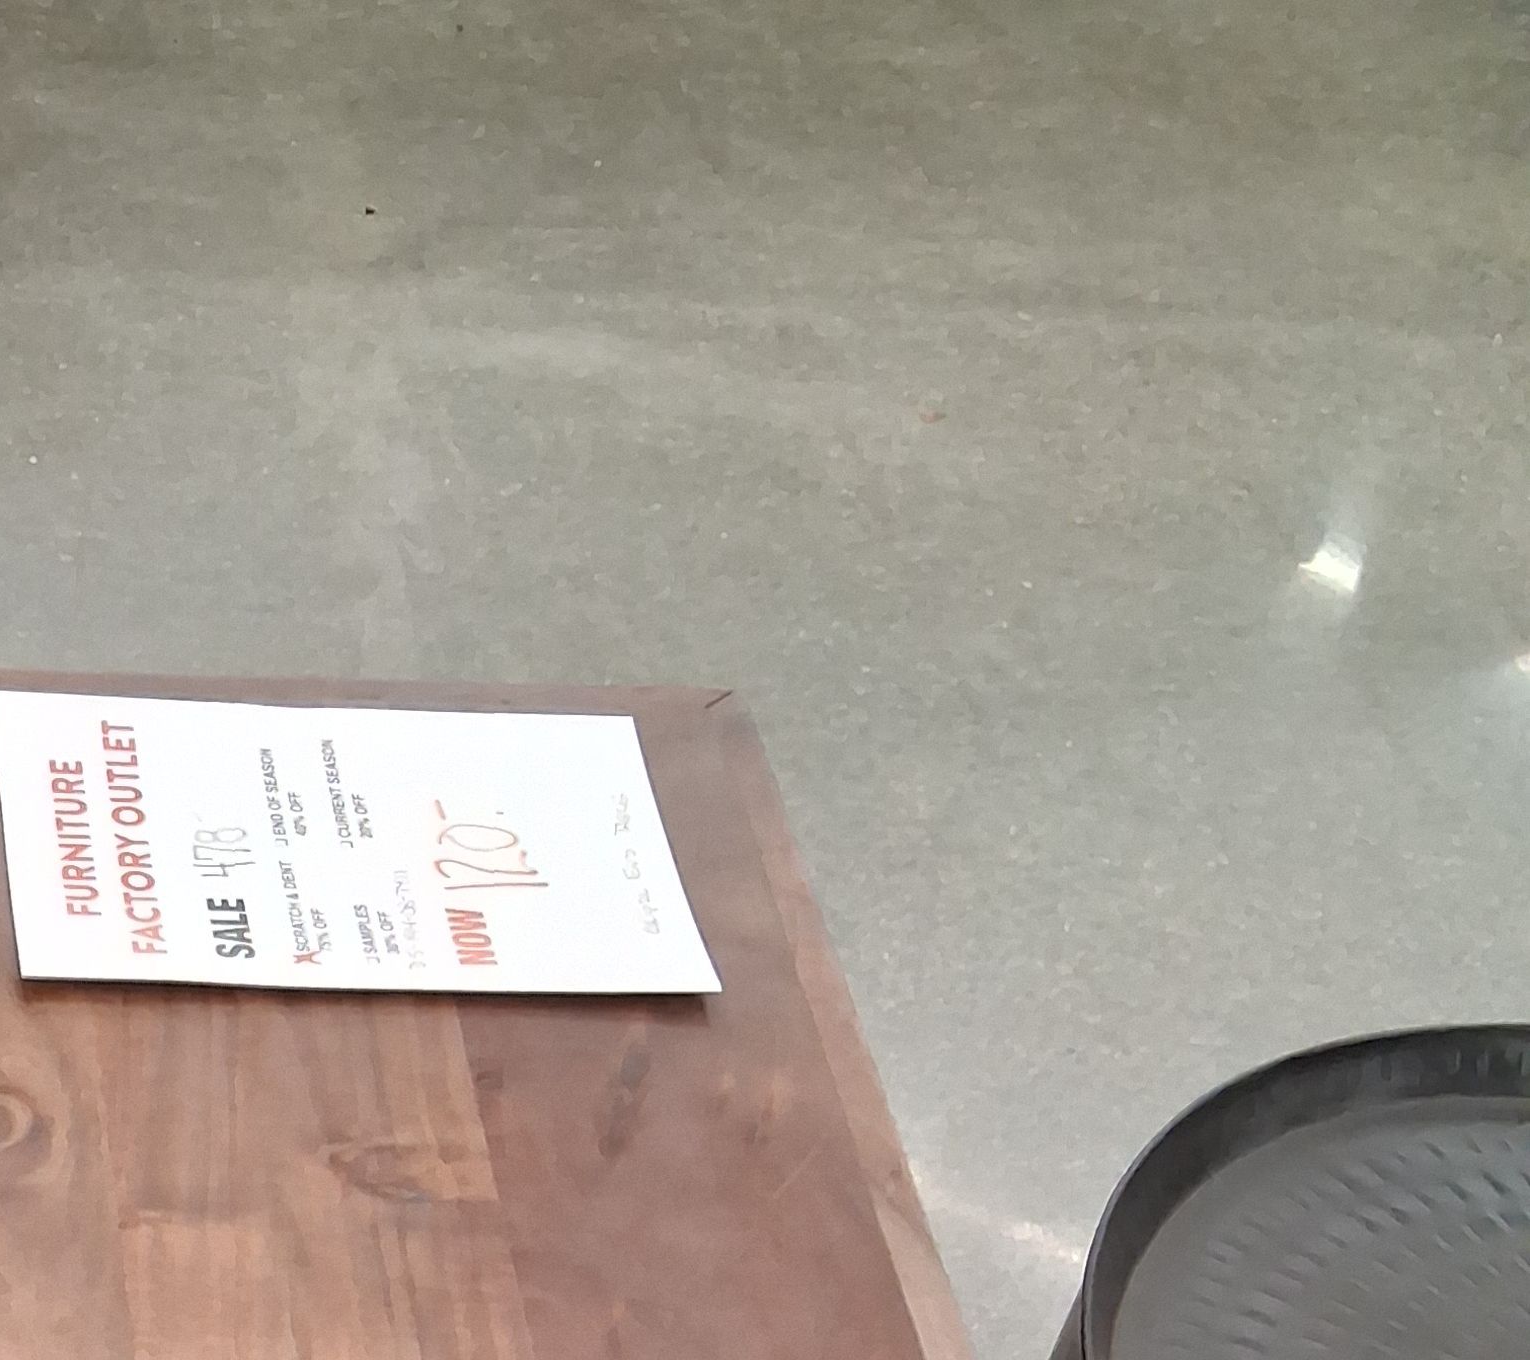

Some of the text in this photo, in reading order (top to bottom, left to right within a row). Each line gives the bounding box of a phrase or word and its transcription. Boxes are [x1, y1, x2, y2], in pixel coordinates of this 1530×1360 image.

[260, 748, 286, 836] END OF SEASON
[288, 792, 303, 812] OFF
[321, 740, 351, 838] CURRENT SEASON
[351, 794, 368, 814] OFF
[49, 760, 101, 916] FURNITURE
[101, 720, 168, 954] FACTORY OUTLET
[279, 860, 296, 889] DENT
[206, 898, 255, 958] SALE
[288, 903, 310, 951] SCRATCH
[310, 908, 327, 929] OFF
[353, 904, 377, 953] SAMPLES
[377, 911, 394, 931] OFF
[444, 908, 498, 965] NOW
